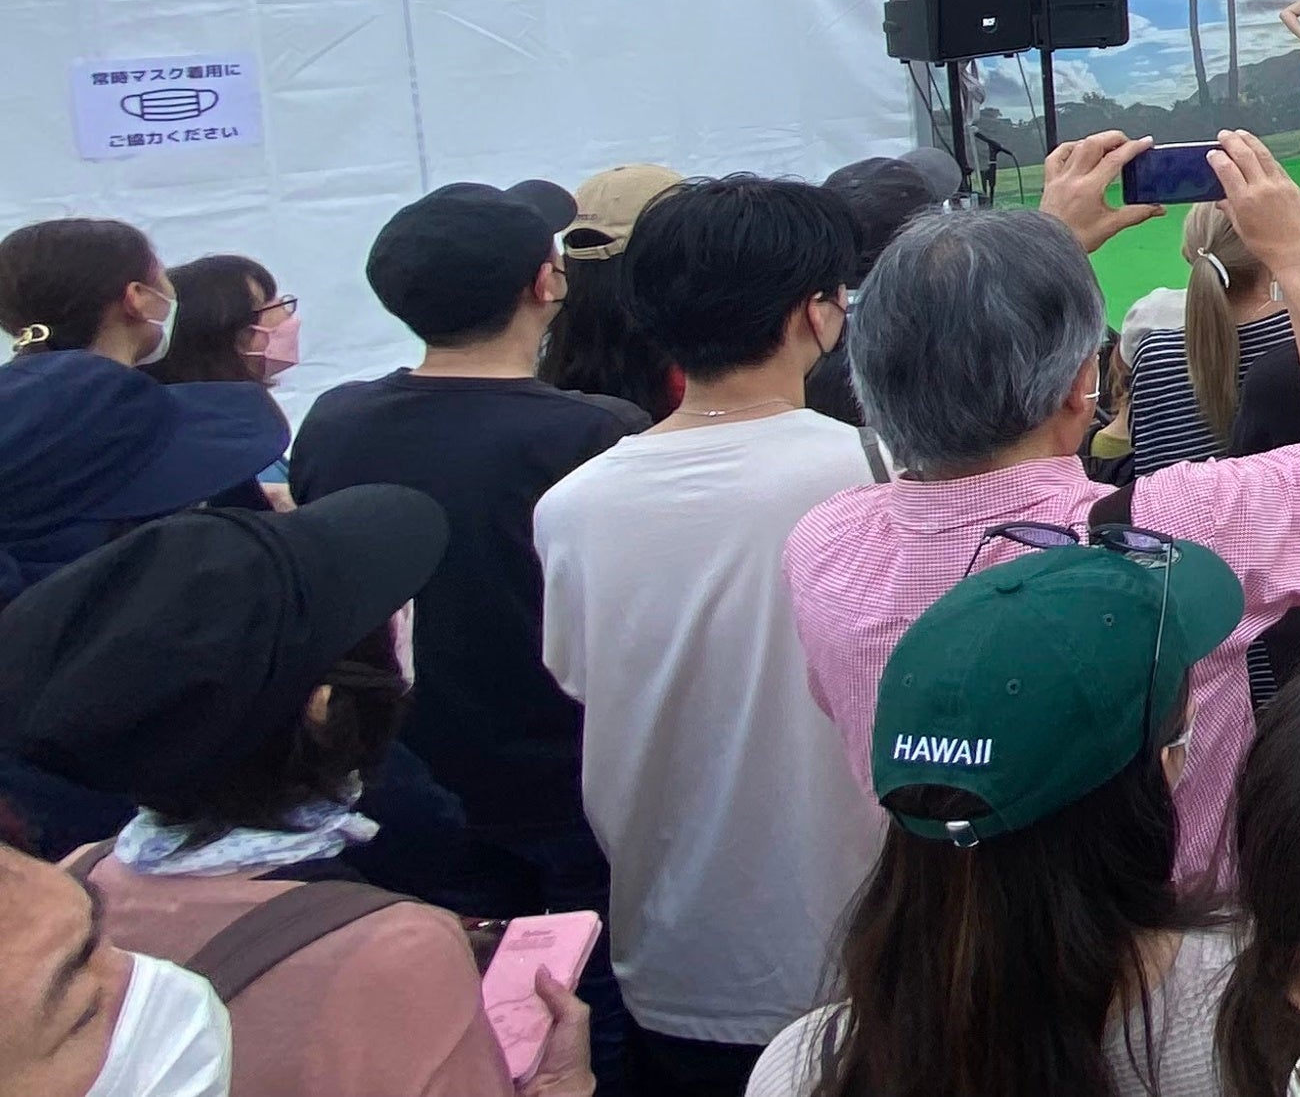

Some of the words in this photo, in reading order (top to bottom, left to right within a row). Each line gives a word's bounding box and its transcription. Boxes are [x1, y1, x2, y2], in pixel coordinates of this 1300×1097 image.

[91, 63, 242, 86] 常時マスク着用に
[109, 126, 239, 148] ご協力ください
[893, 734, 993, 765] HAWAII
